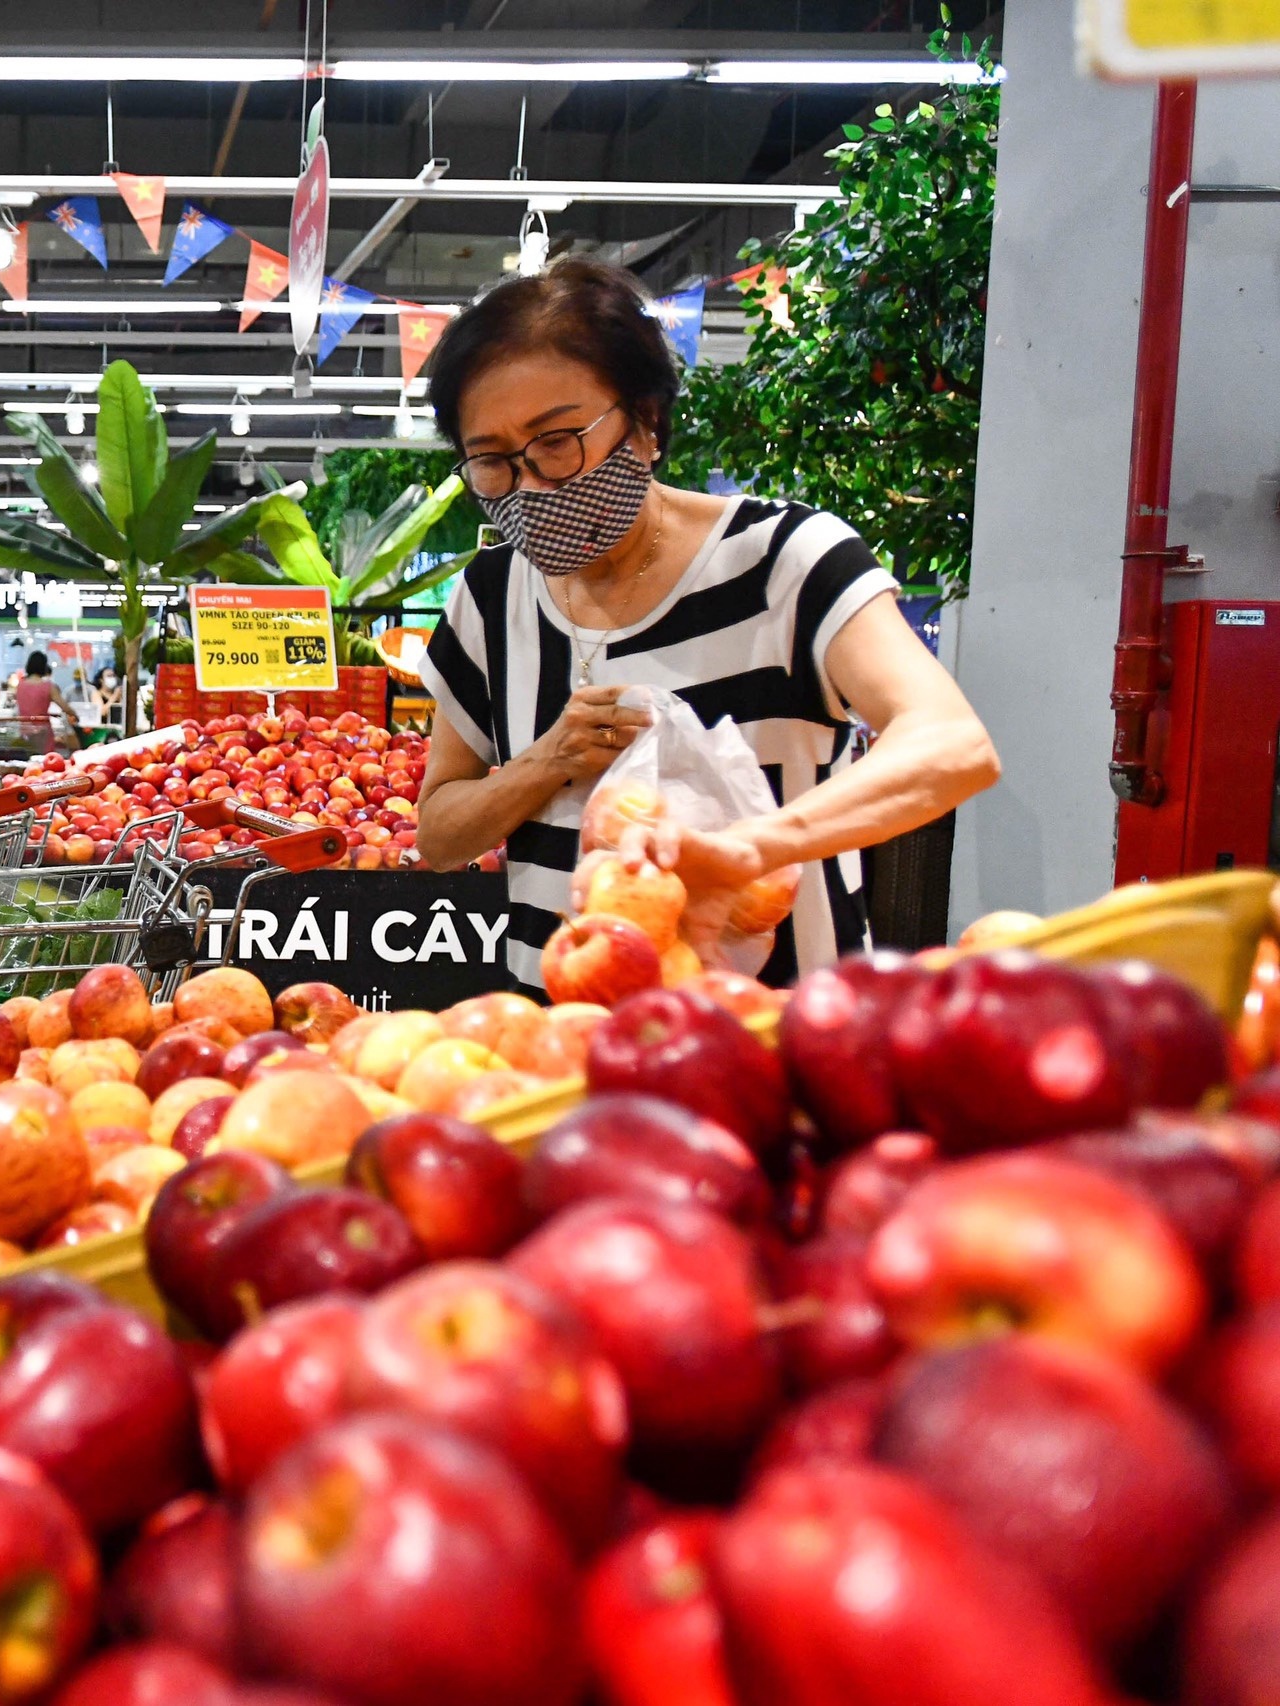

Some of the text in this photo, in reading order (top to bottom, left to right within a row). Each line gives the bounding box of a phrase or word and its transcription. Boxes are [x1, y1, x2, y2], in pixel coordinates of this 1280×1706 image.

[199, 611, 227, 619] VMNK
[252, 611, 284, 620] QUEEN
[232, 621, 290, 630] SIZE 90-120
[206, 652, 259, 665] 79.900
[288, 645, 324, 660] 11%
[207, 896, 510, 963] TRÁI CÂY
